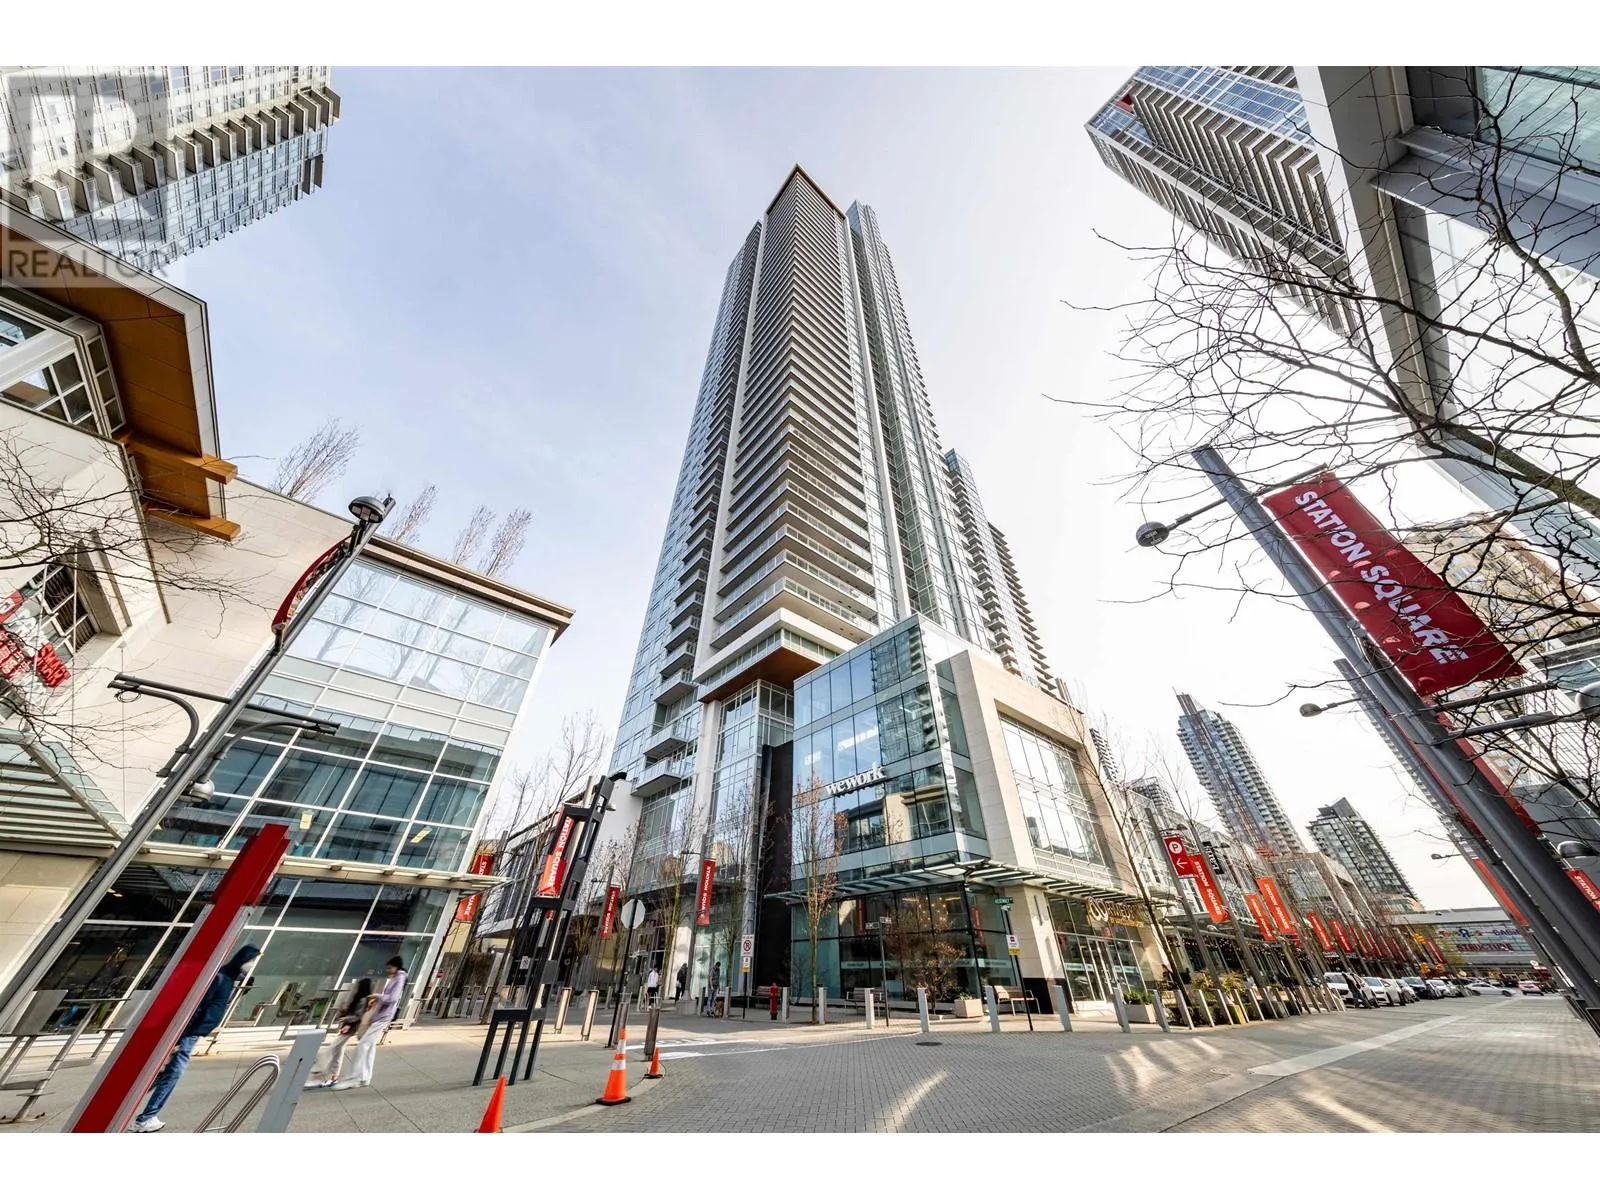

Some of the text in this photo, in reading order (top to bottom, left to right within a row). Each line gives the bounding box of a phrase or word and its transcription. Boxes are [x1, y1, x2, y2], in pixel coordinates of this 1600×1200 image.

[1295, 490, 1470, 665] STATION SQUARE
[556, 816, 573, 850] TATION
[1194, 861, 1210, 887] STATION
[1206, 888, 1223, 916] SQUARE
[1574, 875, 1598, 900] STATION
